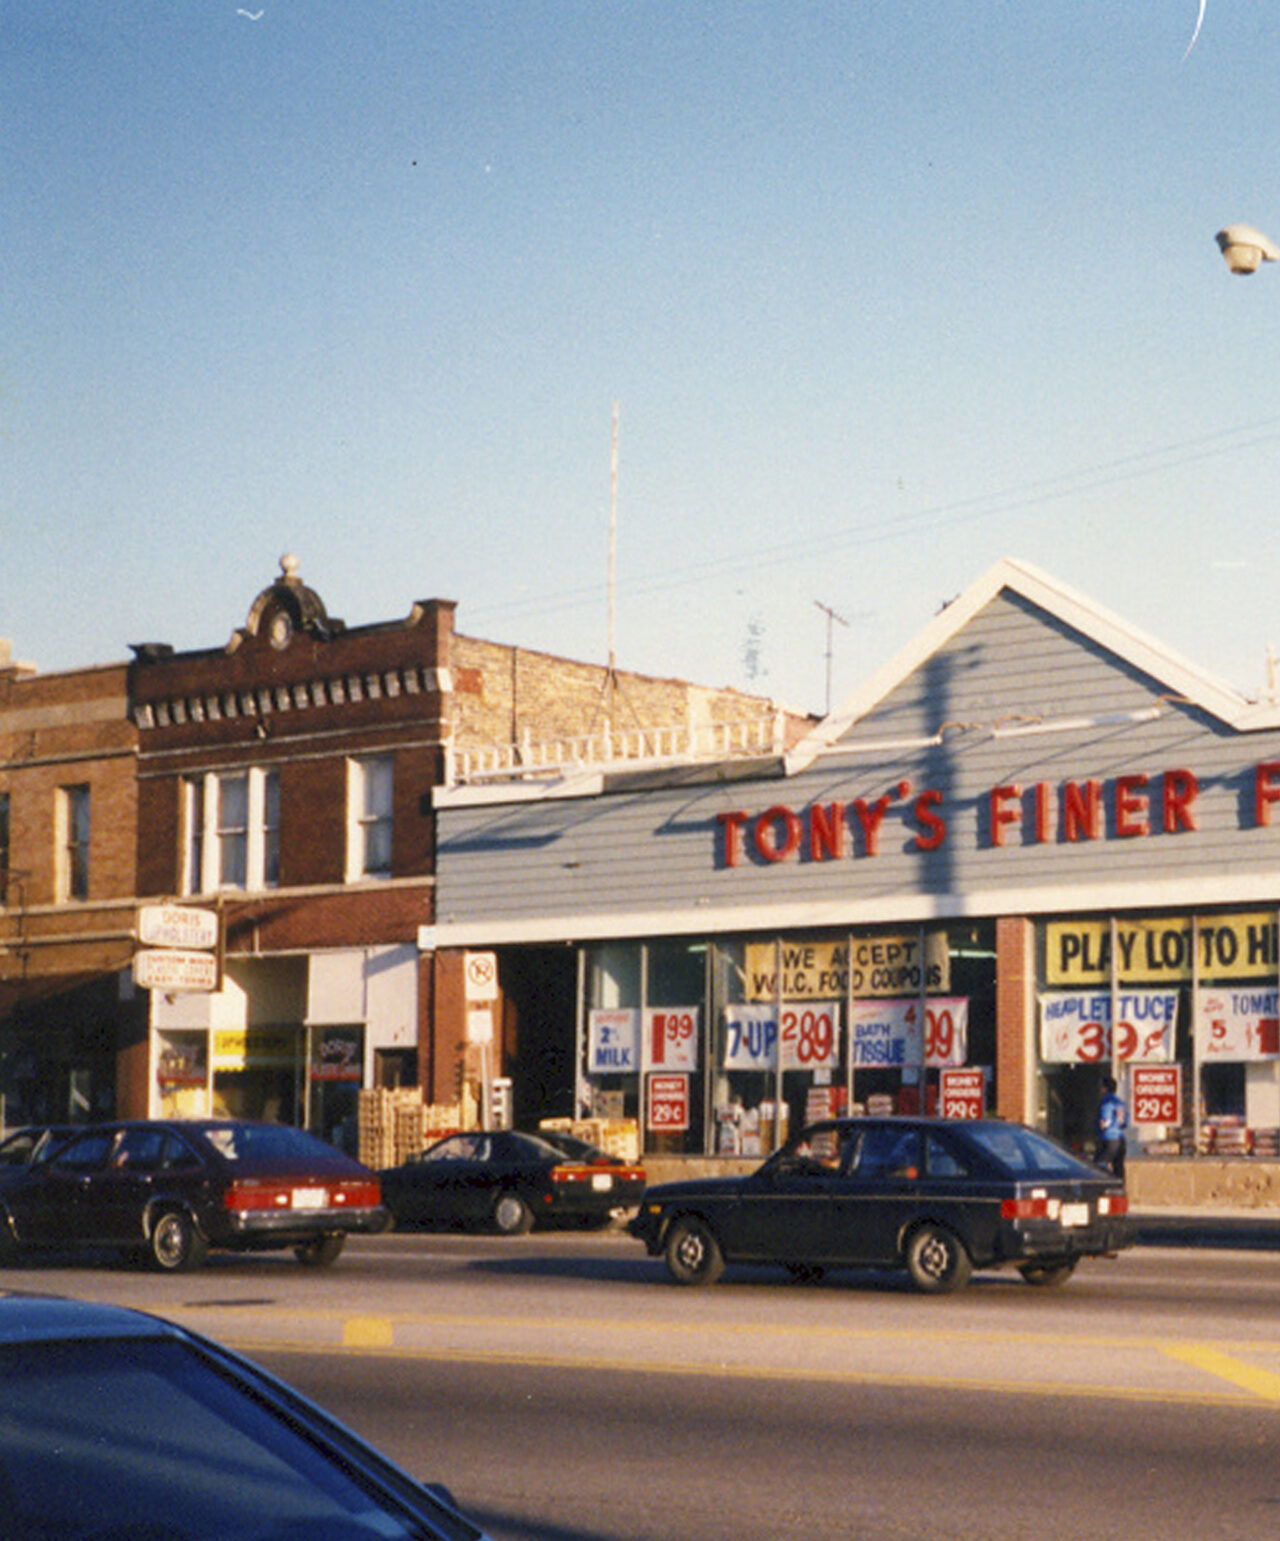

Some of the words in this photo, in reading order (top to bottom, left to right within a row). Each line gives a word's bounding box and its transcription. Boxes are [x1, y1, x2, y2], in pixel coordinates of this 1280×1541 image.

[716, 779, 947, 868] TONY'S
[989, 768, 1199, 848] FINER
[783, 949, 816, 969] WE
[830, 941, 918, 968] ACCEPT
[1060, 931, 1136, 972] PLAY
[1145, 926, 1238, 969] LOTTO
[818, 971, 864, 991] FOOD
[870, 964, 942, 989] COUPONS
[1078, 996, 1175, 1020] LETTUCE
[855, 1023, 891, 1038] BATH
[595, 1047, 630, 1066] MILK
[853, 1038, 905, 1063] TISSUE
[947, 1076, 979, 1086] MONEY
[1138, 1073, 1173, 1082] MONEY
[944, 1088, 981, 1098] ORDERS
[1136, 1085, 1175, 1095] ORDERS
